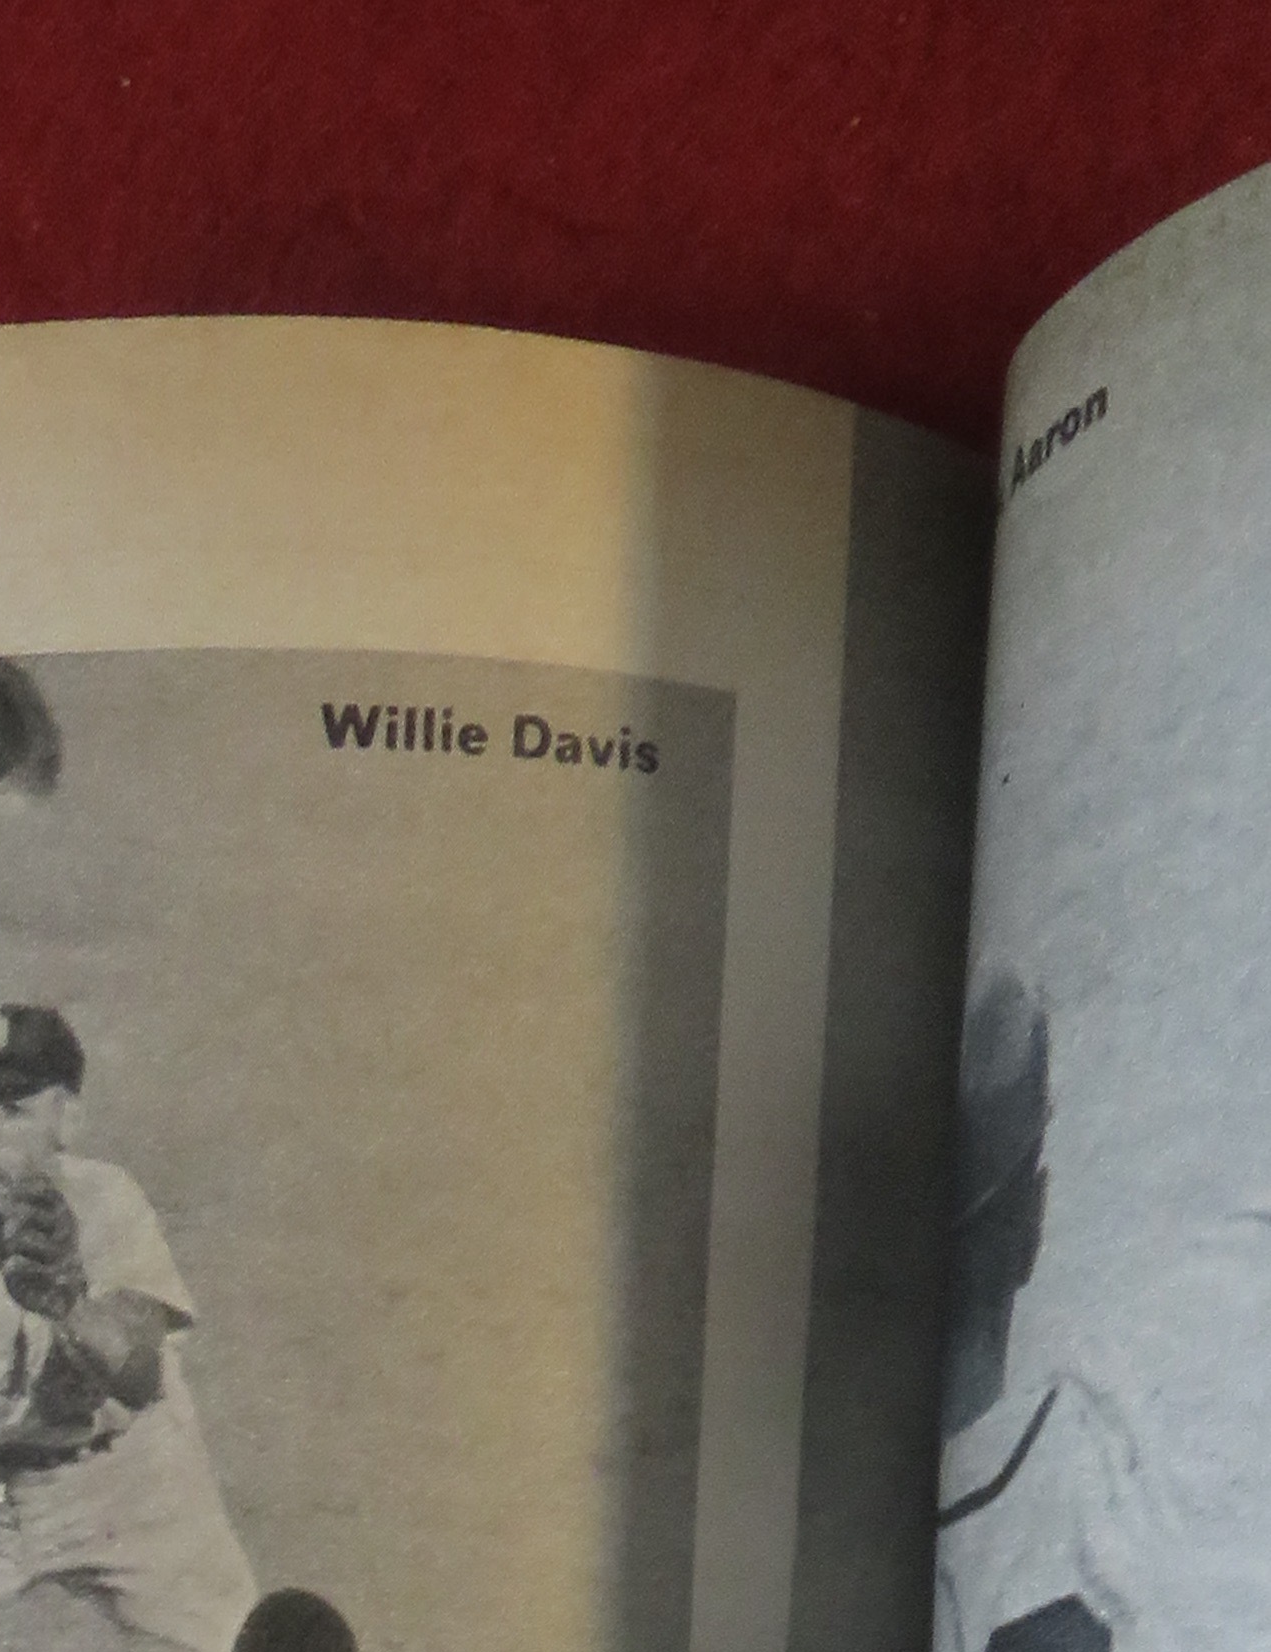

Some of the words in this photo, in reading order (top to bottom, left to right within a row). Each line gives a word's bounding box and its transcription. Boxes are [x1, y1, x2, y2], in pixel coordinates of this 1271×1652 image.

[1010, 386, 1109, 498] Aaron
[320, 702, 489, 757] Willie
[512, 713, 659, 775] Davis
